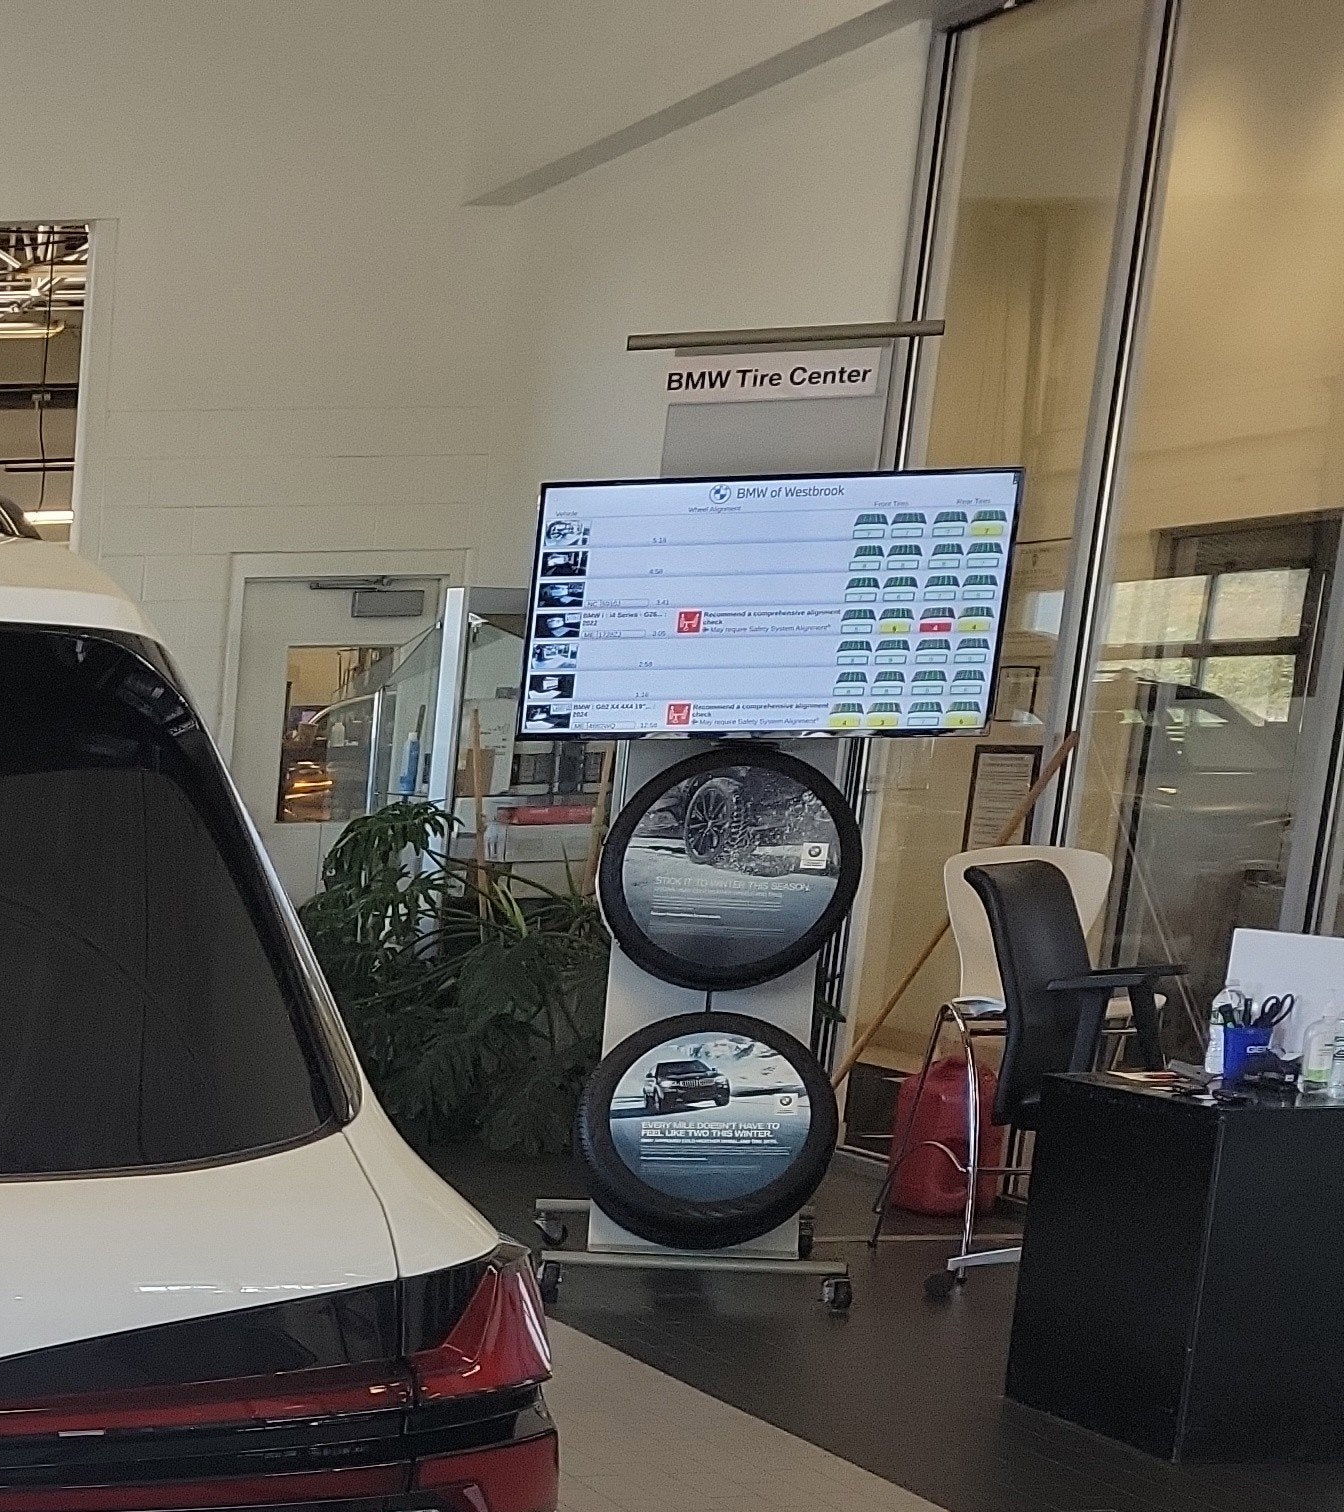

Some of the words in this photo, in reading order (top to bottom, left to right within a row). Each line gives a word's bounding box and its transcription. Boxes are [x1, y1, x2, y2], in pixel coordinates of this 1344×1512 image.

[667, 370, 731, 391] BMW
[736, 368, 782, 387] Tire
[790, 366, 872, 386] Center
[737, 487, 767, 499] BMW
[770, 486, 782, 498] of
[784, 485, 844, 498] Westbrook
[710, 505, 741, 513] Alignment
[753, 609, 805, 618] comprehensive
[806, 609, 841, 617] alignment
[742, 703, 794, 711] comprehensive
[795, 702, 829, 710] alignment
[748, 881, 769, 890] THIS
[641, 1121, 670, 1129] EVERY
[697, 1122, 737, 1130] DOESN'T
[739, 1122, 763, 1130] HAVE
[641, 1129, 664, 1137] FEEL
[665, 1129, 686, 1137] LIKE
